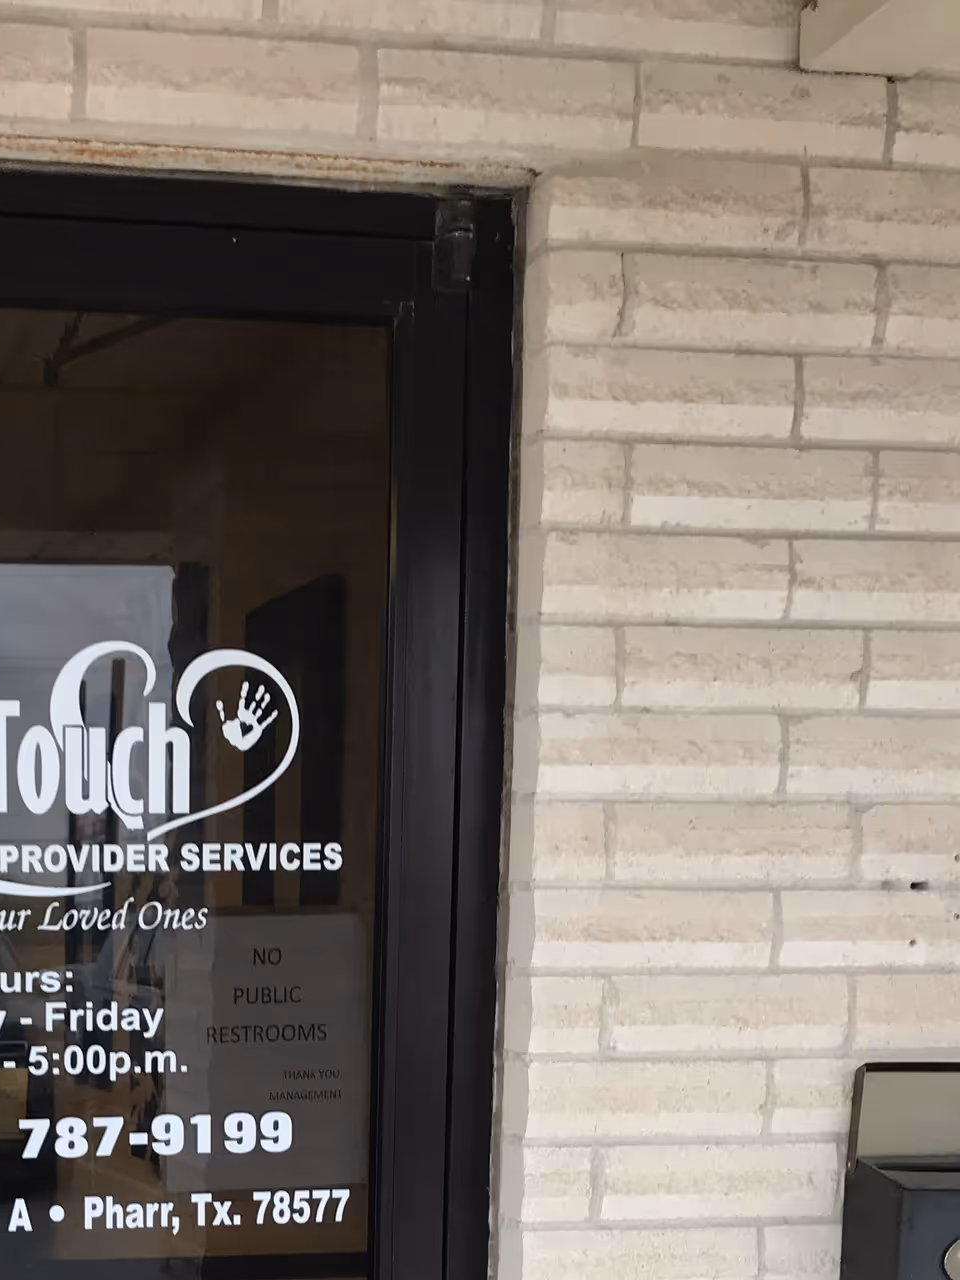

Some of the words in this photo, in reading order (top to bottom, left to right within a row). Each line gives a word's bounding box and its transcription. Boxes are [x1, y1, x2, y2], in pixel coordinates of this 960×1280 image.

[0, 842, 170, 874] PROVIDER
[180, 842, 343, 872] SERVICES
[38, 897, 135, 932] Loved
[138, 900, 209, 930] Ones
[251, 947, 282, 967] NO
[233, 985, 303, 1005] PUBLIC
[45, 1001, 164, 1039] Friday
[206, 1023, 328, 1044] RESTROOMS
[28, 1044, 189, 1082] 5:00p.m.
[283, 1069, 316, 1081] THANK
[18, 1111, 294, 1159] 787-9199
[7, 1198, 33, 1233] A
[84, 1195, 180, 1236] Pharr,
[190, 1192, 243, 1227] Tx.
[252, 1188, 351, 1225] 78577
